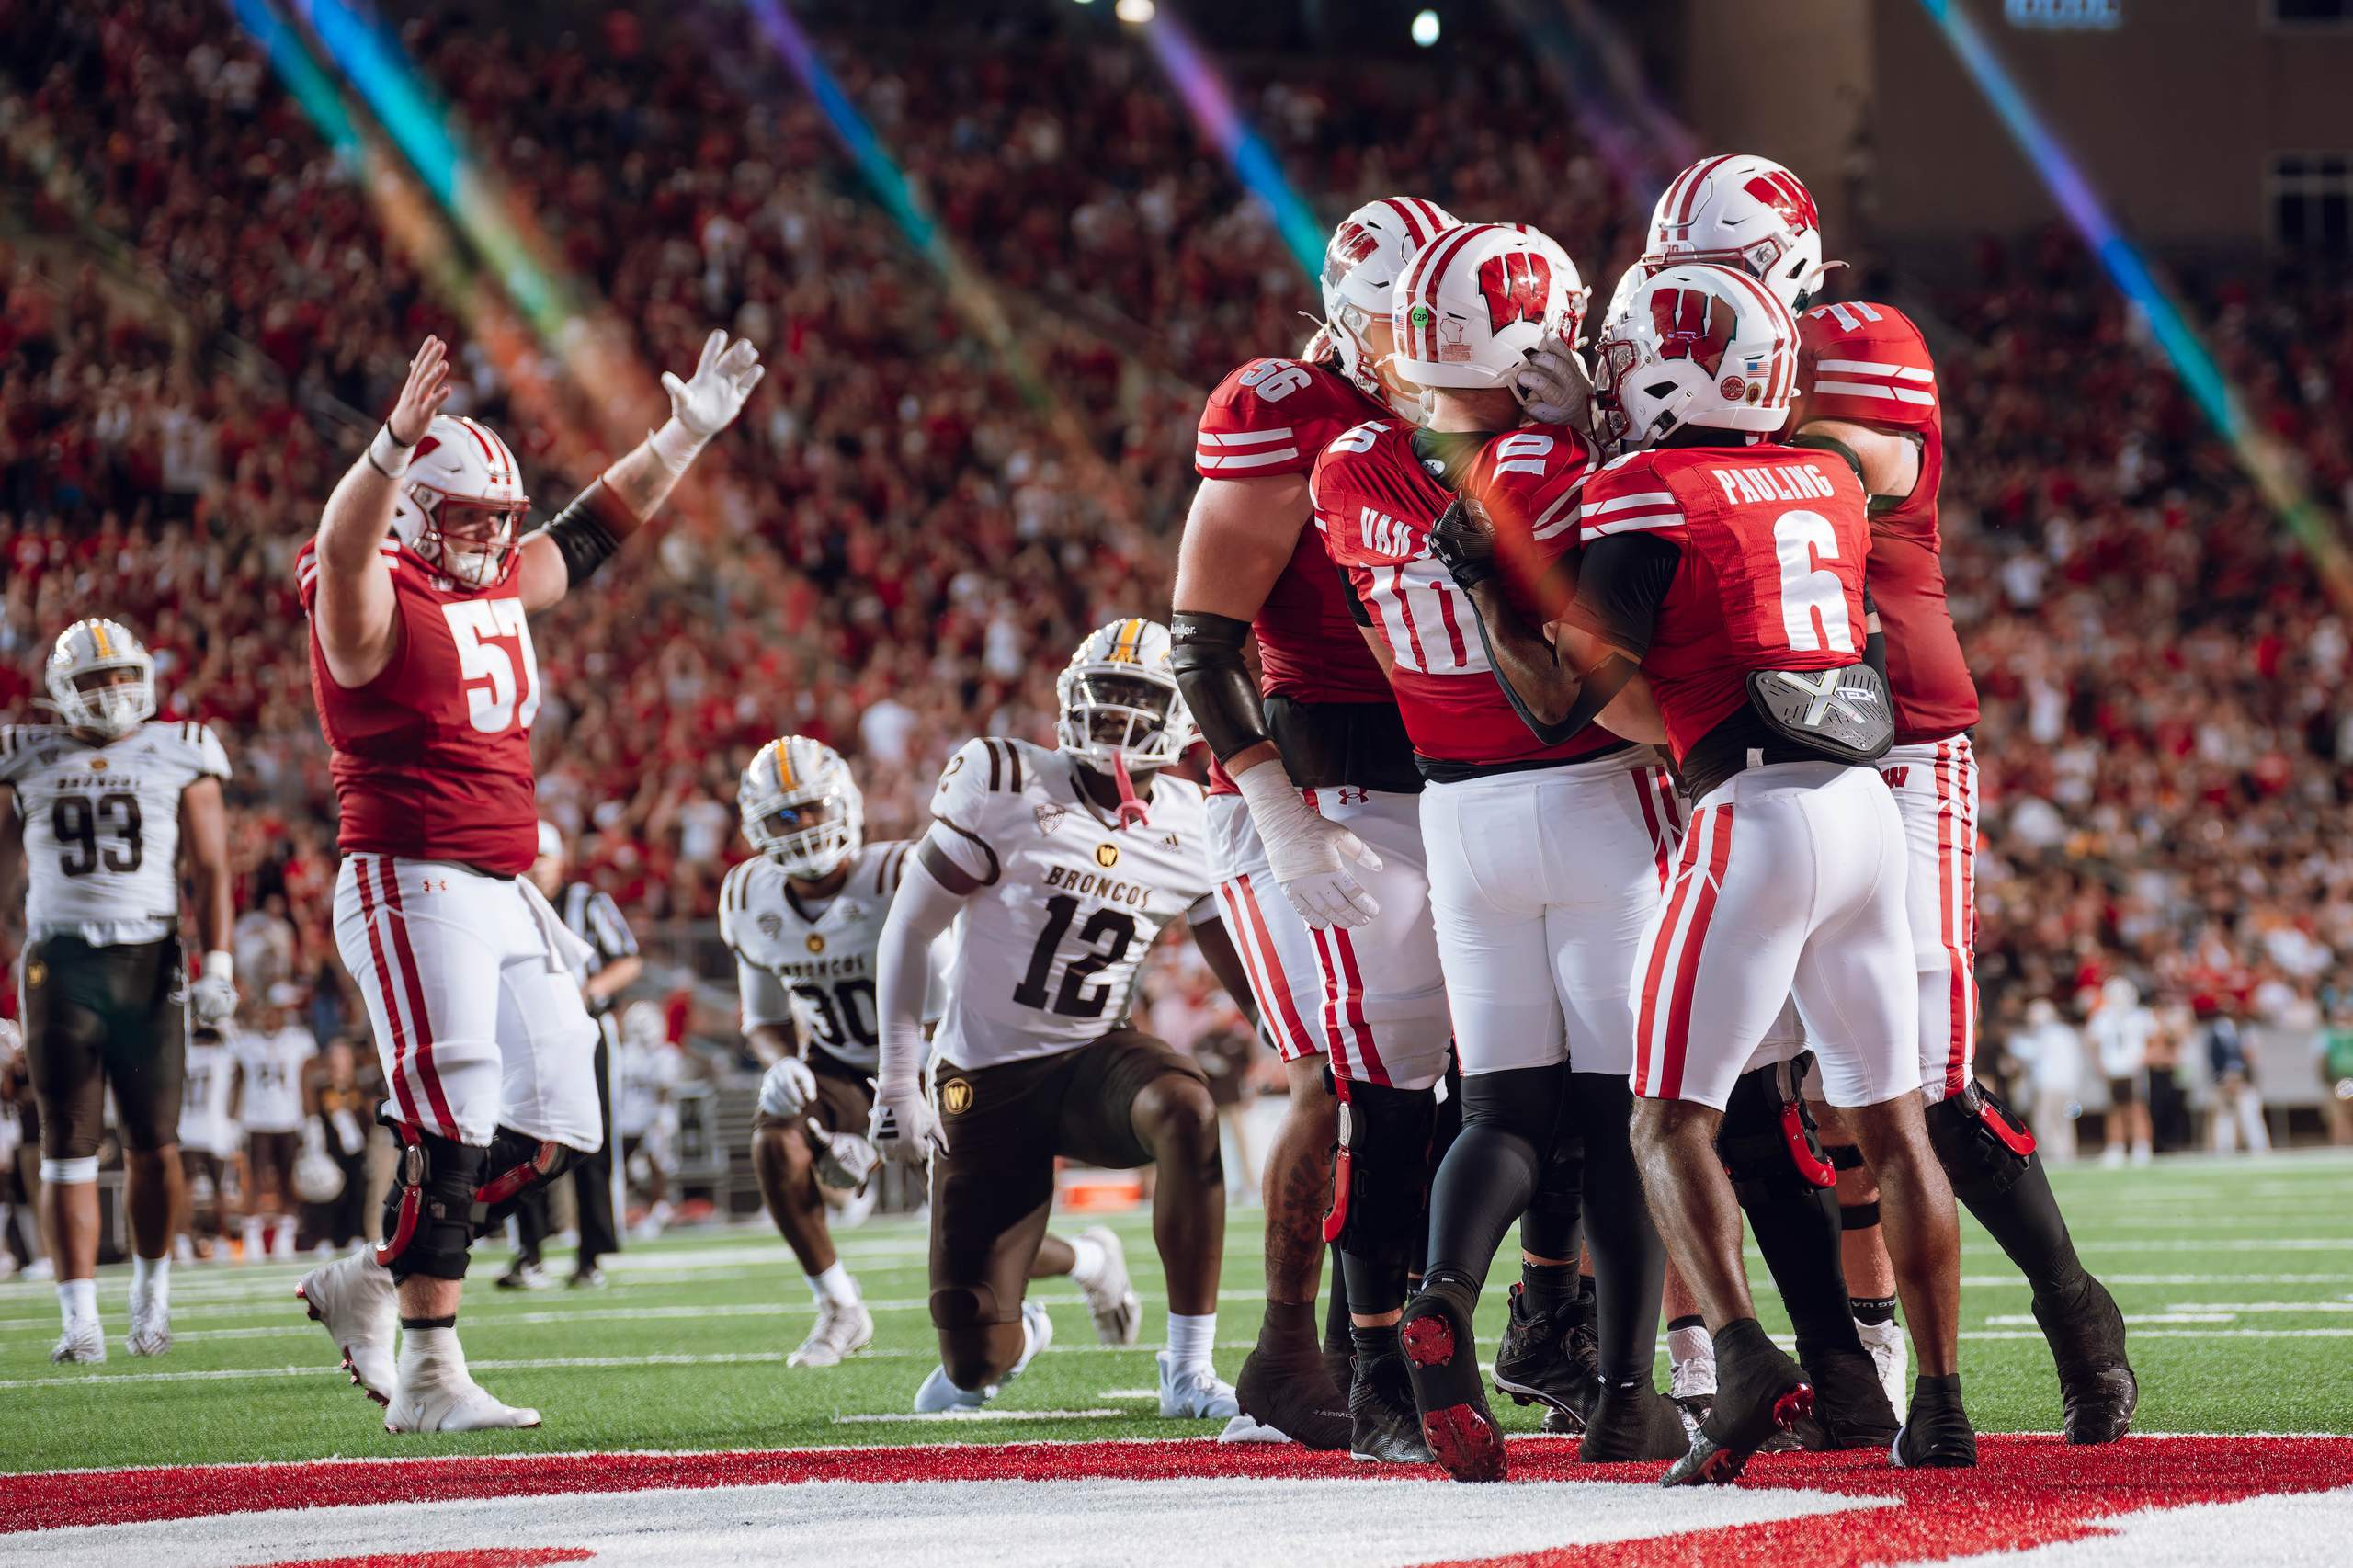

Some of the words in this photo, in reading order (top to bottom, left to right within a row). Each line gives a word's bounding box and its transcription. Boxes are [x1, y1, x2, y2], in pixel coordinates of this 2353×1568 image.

[1413, 312, 1427, 322] C2P
[1476, 251, 1552, 339] W
[1650, 288, 1738, 382] W
[1238, 358, 1313, 403] 56
[1493, 433, 1554, 477] 10
[1711, 464, 1835, 506] PAULING
[1360, 506, 1414, 558] VAN
[1358, 557, 1496, 676] 10
[1773, 509, 1856, 653] 6
[441, 597, 541, 733] 57
[52, 793, 142, 878] 93
[1045, 866, 1154, 909] BRONCOS
[1013, 893, 1136, 1017] 12
[791, 978, 881, 1047] 30
